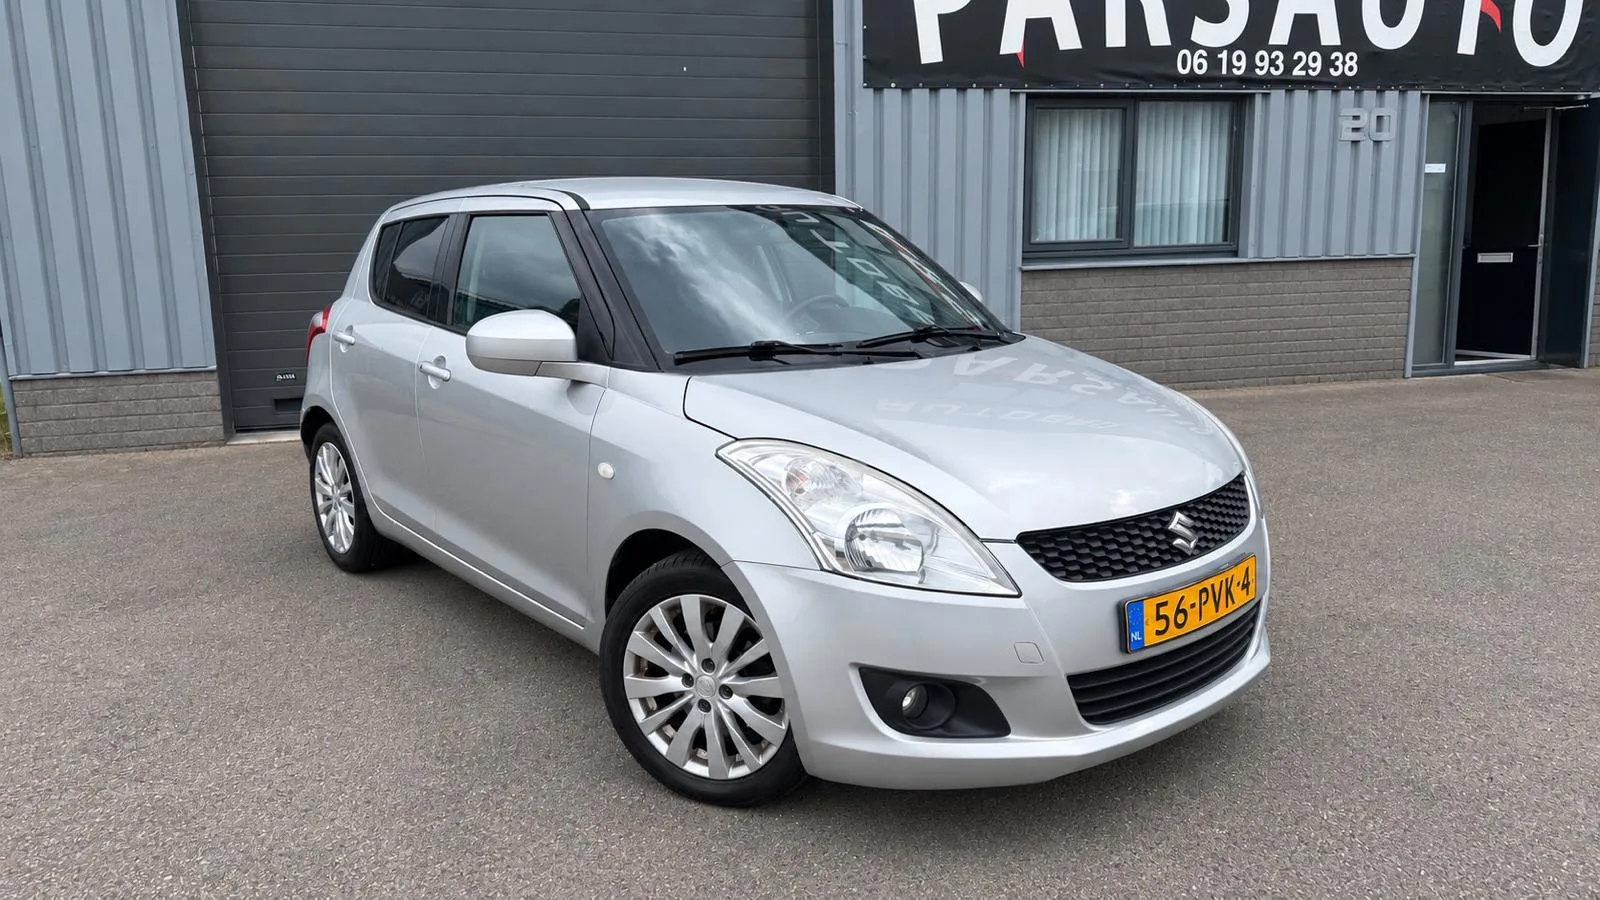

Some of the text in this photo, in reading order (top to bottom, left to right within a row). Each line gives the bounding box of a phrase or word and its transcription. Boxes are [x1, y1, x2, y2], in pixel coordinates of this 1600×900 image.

[1176, 49, 1358, 77] 06 19 93 29 38
[1339, 107, 1396, 142] 20
[1154, 566, 1250, 636] 56-PVK-4
[1130, 631, 1143, 642] NL
